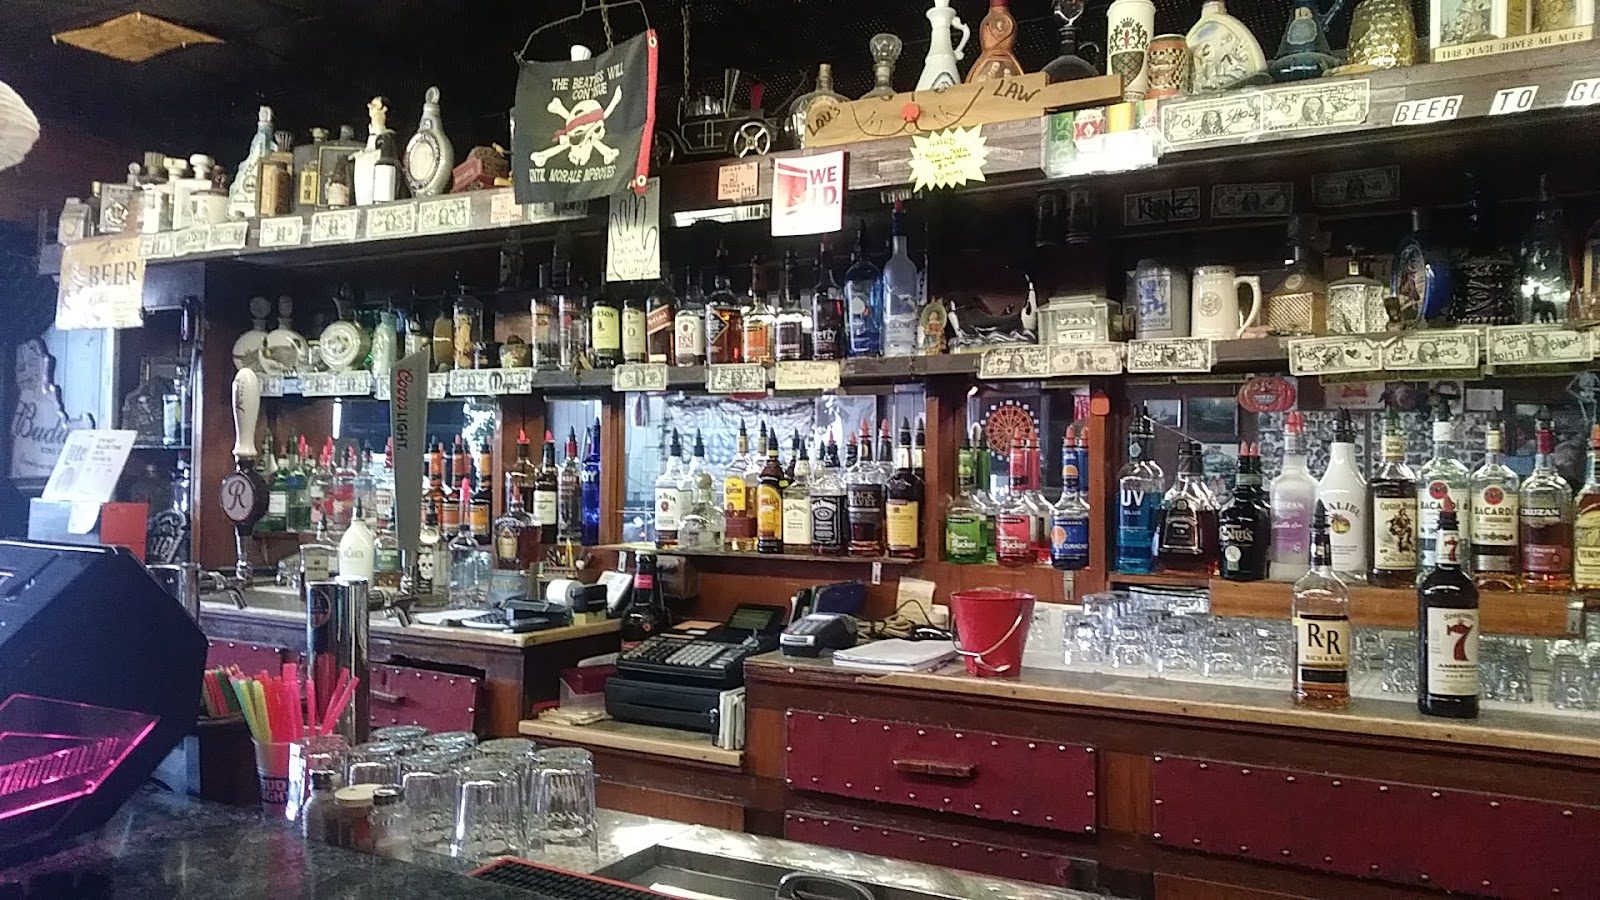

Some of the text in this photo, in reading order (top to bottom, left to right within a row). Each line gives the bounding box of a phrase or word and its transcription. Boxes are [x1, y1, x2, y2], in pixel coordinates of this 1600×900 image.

[552, 77, 569, 91] THE
[606, 62, 624, 81] WILL
[993, 78, 1042, 104] LAW
[1395, 97, 1460, 123] BEER
[1498, 89, 1534, 111] TO
[549, 168, 582, 183] MORALE
[809, 165, 837, 185] WE
[89, 261, 137, 288] BEER
[396, 411, 408, 451] LIGHT
[1120, 488, 1145, 507] UV
[1446, 620, 1474, 662] 7
